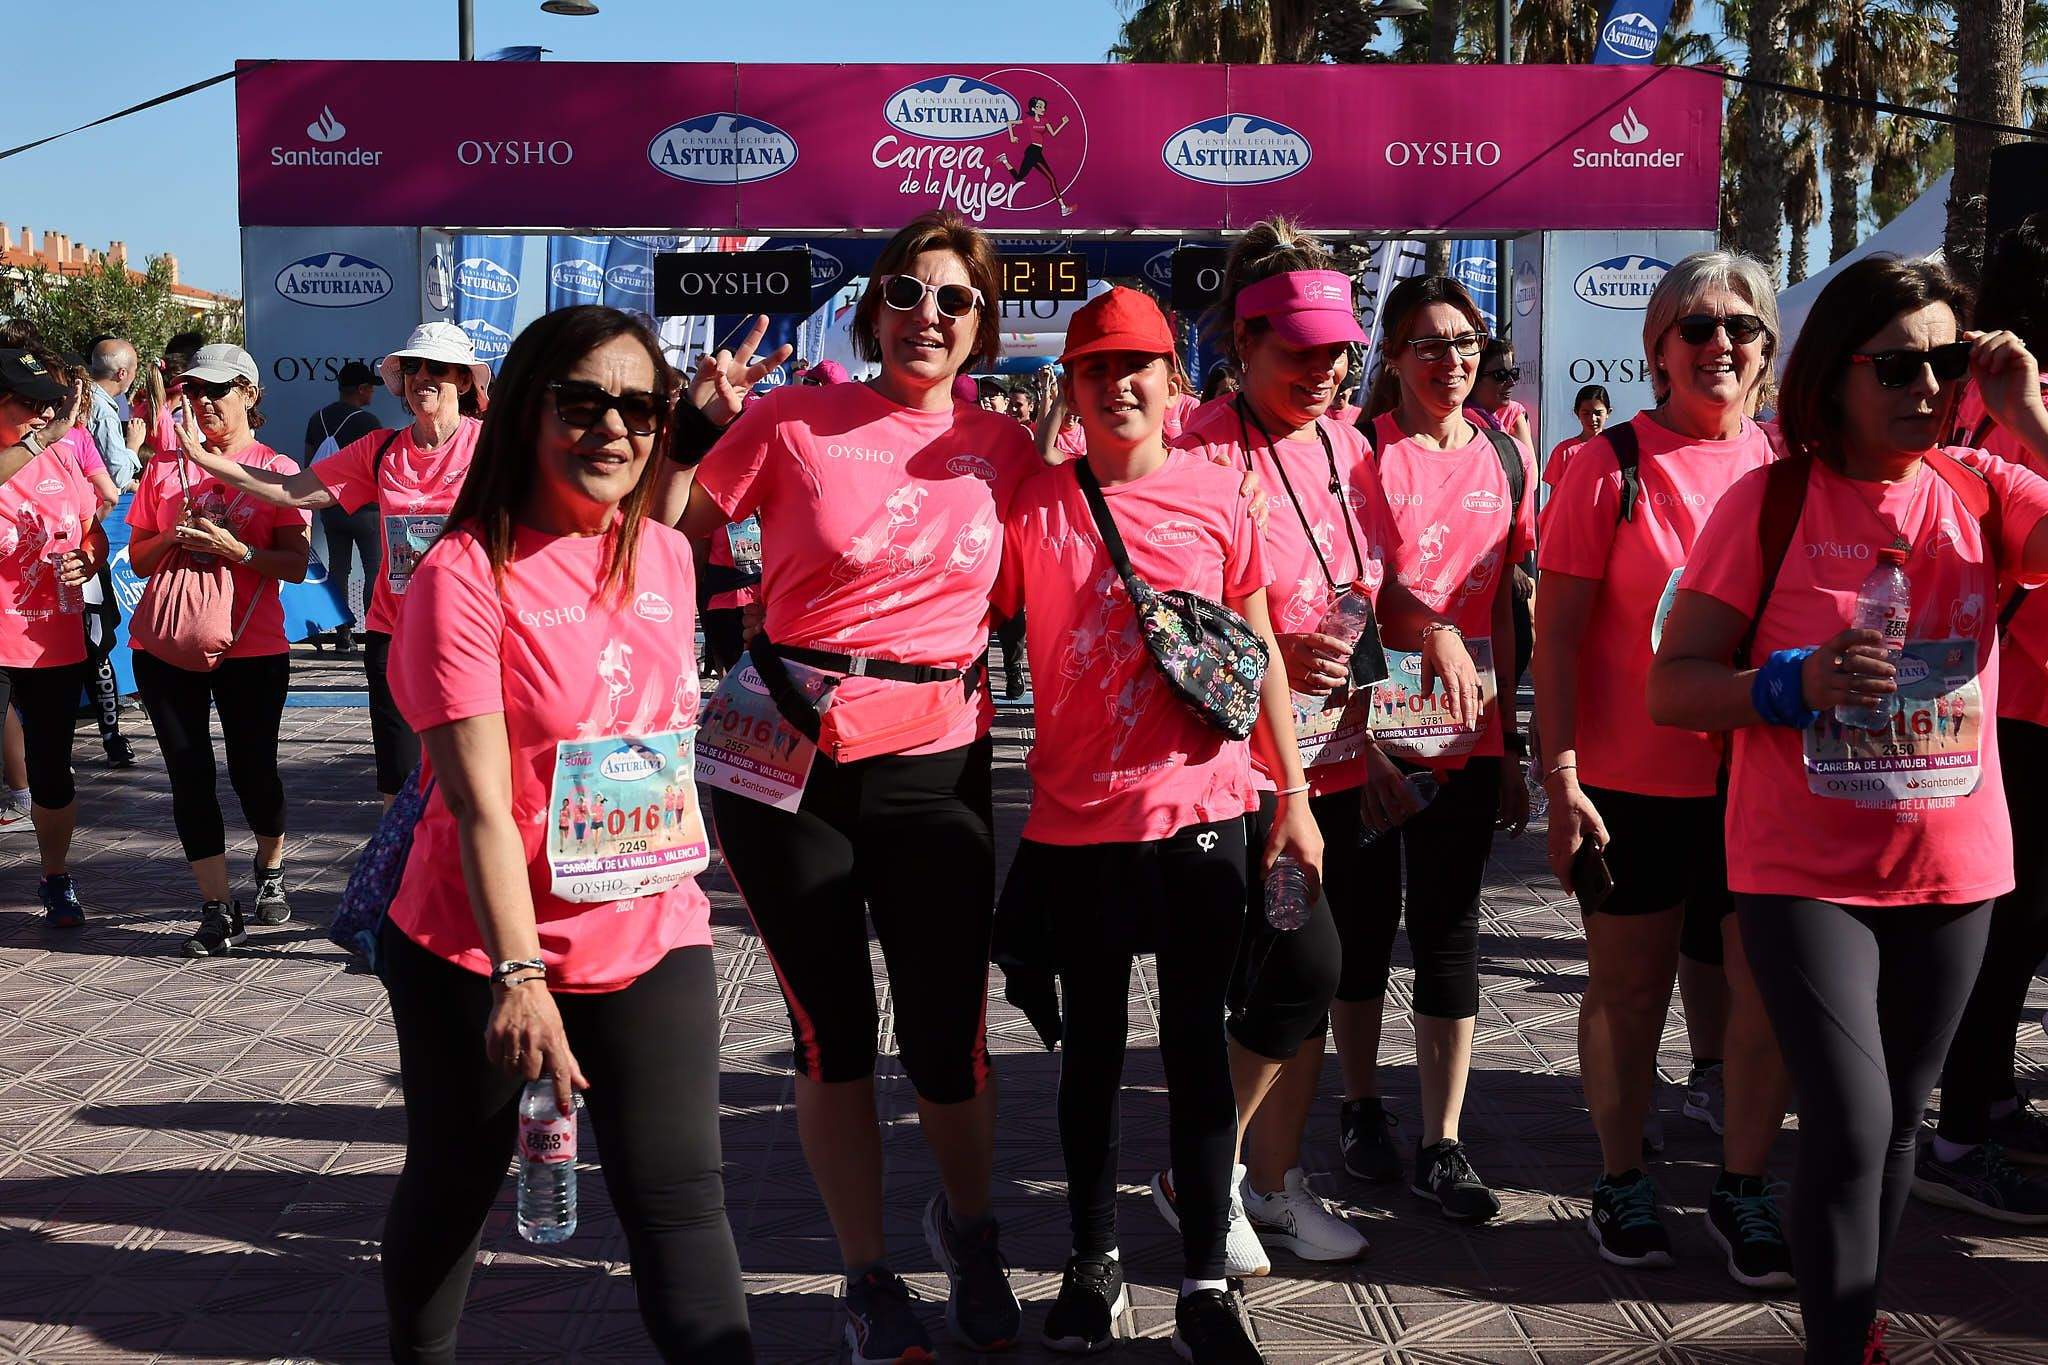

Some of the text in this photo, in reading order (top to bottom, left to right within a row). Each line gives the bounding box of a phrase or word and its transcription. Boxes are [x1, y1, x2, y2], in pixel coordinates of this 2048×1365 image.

[1607, 25, 1654, 51] ASTURIANA
[894, 98, 1010, 123] ASTURIANA
[682, 136, 729, 145] CENTRAL
[1197, 138, 1295, 146] CENTRAL LECHERA
[271, 147, 383, 166] Santander
[457, 140, 573, 165] OYSHO
[659, 139, 786, 165] ASTURIANA
[872, 135, 985, 168] Carrera
[1174, 140, 1301, 166] ASTURIANA
[1385, 141, 1501, 166] OYSHO
[1573, 149, 1684, 168] Santander
[900, 166, 1026, 221] de la Mujer
[284, 273, 384, 294] ASTURIANA
[680, 272, 789, 296] OYSHO
[1003, 261, 1076, 292] 12:15
[1583, 275, 1656, 296] ASTURIA
[273, 357, 384, 381] OYS
[827, 444, 894, 464] OYSHO
[951, 461, 994, 478] ASTURIANA
[1387, 493, 1423, 506] YSHO
[1654, 492, 1705, 506] OYSHO
[1805, 542, 1870, 560] OYSHO
[96, 659, 117, 725] adida
[723, 710, 772, 743] 016
[1421, 717, 1443, 726] 3781
[1376, 728, 1408, 739] CARRERA
[1408, 727, 1418, 737] DE
[1419, 727, 1429, 736] LA
[1430, 725, 1454, 735] MUJER
[725, 738, 750, 754] 2557
[1300, 747, 1331, 760] YSHO
[1883, 743, 1915, 756] 2250
[709, 748, 718, 758] DE
[718, 750, 727, 761] LA
[728, 753, 754, 769] MUJER
[759, 764, 796, 784] VALENCIA
[1817, 761, 1861, 773] CARRERA
[1865, 761, 1876, 770] DE
[1880, 760, 1892, 769] LA
[1895, 758, 1927, 769] MUJER
[1935, 754, 1973, 766] VALENCIA
[740, 778, 785, 800] Santander
[1827, 778, 1885, 791] OYSHO
[1921, 776, 1967, 788] Santander
[1900, 799, 1913, 810] DE
[1914, 799, 1926, 809] LA
[1927, 797, 1956, 809] MUJER
[607, 804, 660, 836] 016
[1896, 812, 1918, 823] 2024
[619, 840, 647, 854] 2249
[605, 860, 617, 870] DE
[617, 858, 630, 868] LA
[664, 847, 700, 862] VALENCIA
[572, 879, 623, 895] OYSHO
[651, 870, 693, 885] Santander
